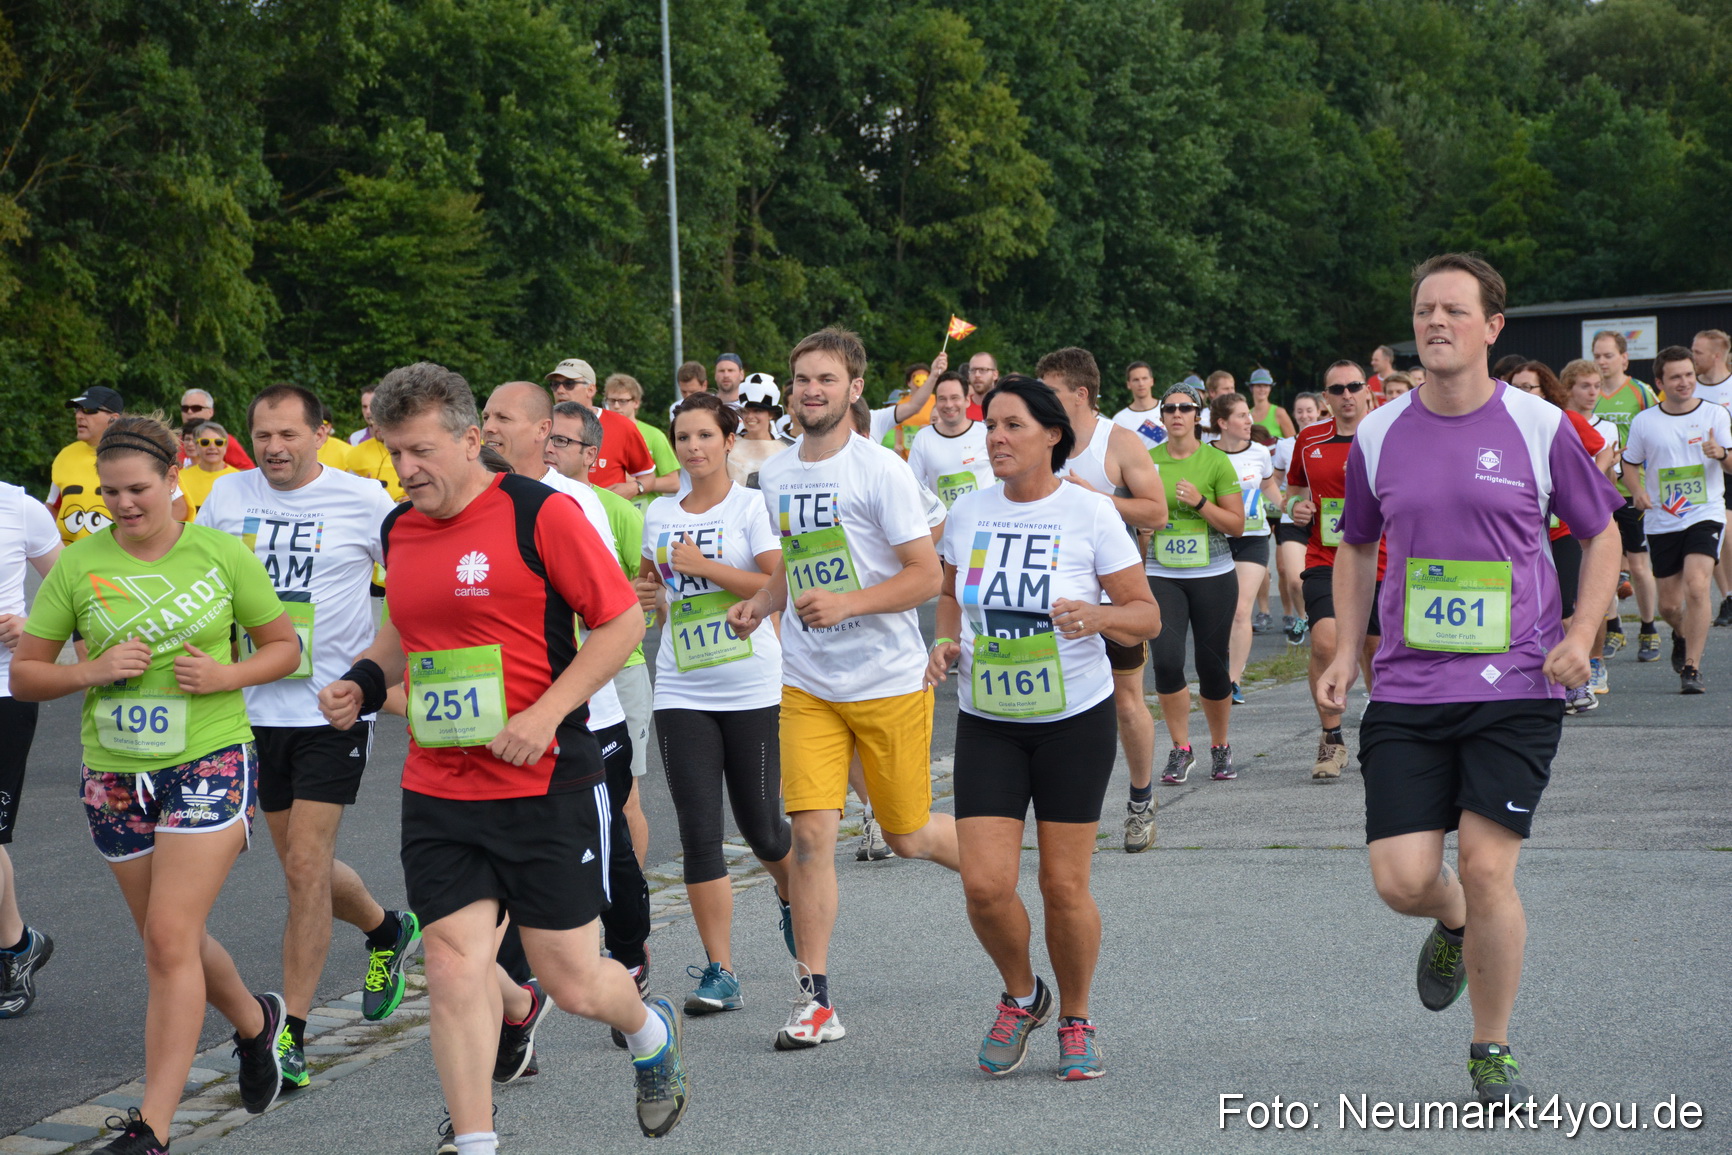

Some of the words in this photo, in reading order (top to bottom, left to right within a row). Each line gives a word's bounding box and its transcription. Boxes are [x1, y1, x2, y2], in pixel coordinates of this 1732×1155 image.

[1475, 473, 1525, 488] Fertigteilwerke
[1665, 481, 1702, 496] 1533
[1014, 522, 1062, 530] WOHNFORMEL
[1165, 539, 1197, 554] 482
[793, 557, 849, 589] 1162
[1422, 574, 1457, 583] firmenlauf
[454, 586, 490, 597] caritas
[1424, 596, 1485, 627] 461
[1036, 621, 1049, 629] NM
[1435, 631, 1458, 639] Günter
[688, 653, 704, 661] Sandra
[980, 667, 1051, 696] 1161
[423, 687, 480, 722] 251
[111, 704, 169, 734] 196
[113, 736, 134, 745] Stefanie
[134, 739, 166, 747] Schweiger
[601, 741, 617, 756] JAKO
[174, 808, 220, 821] adidas
